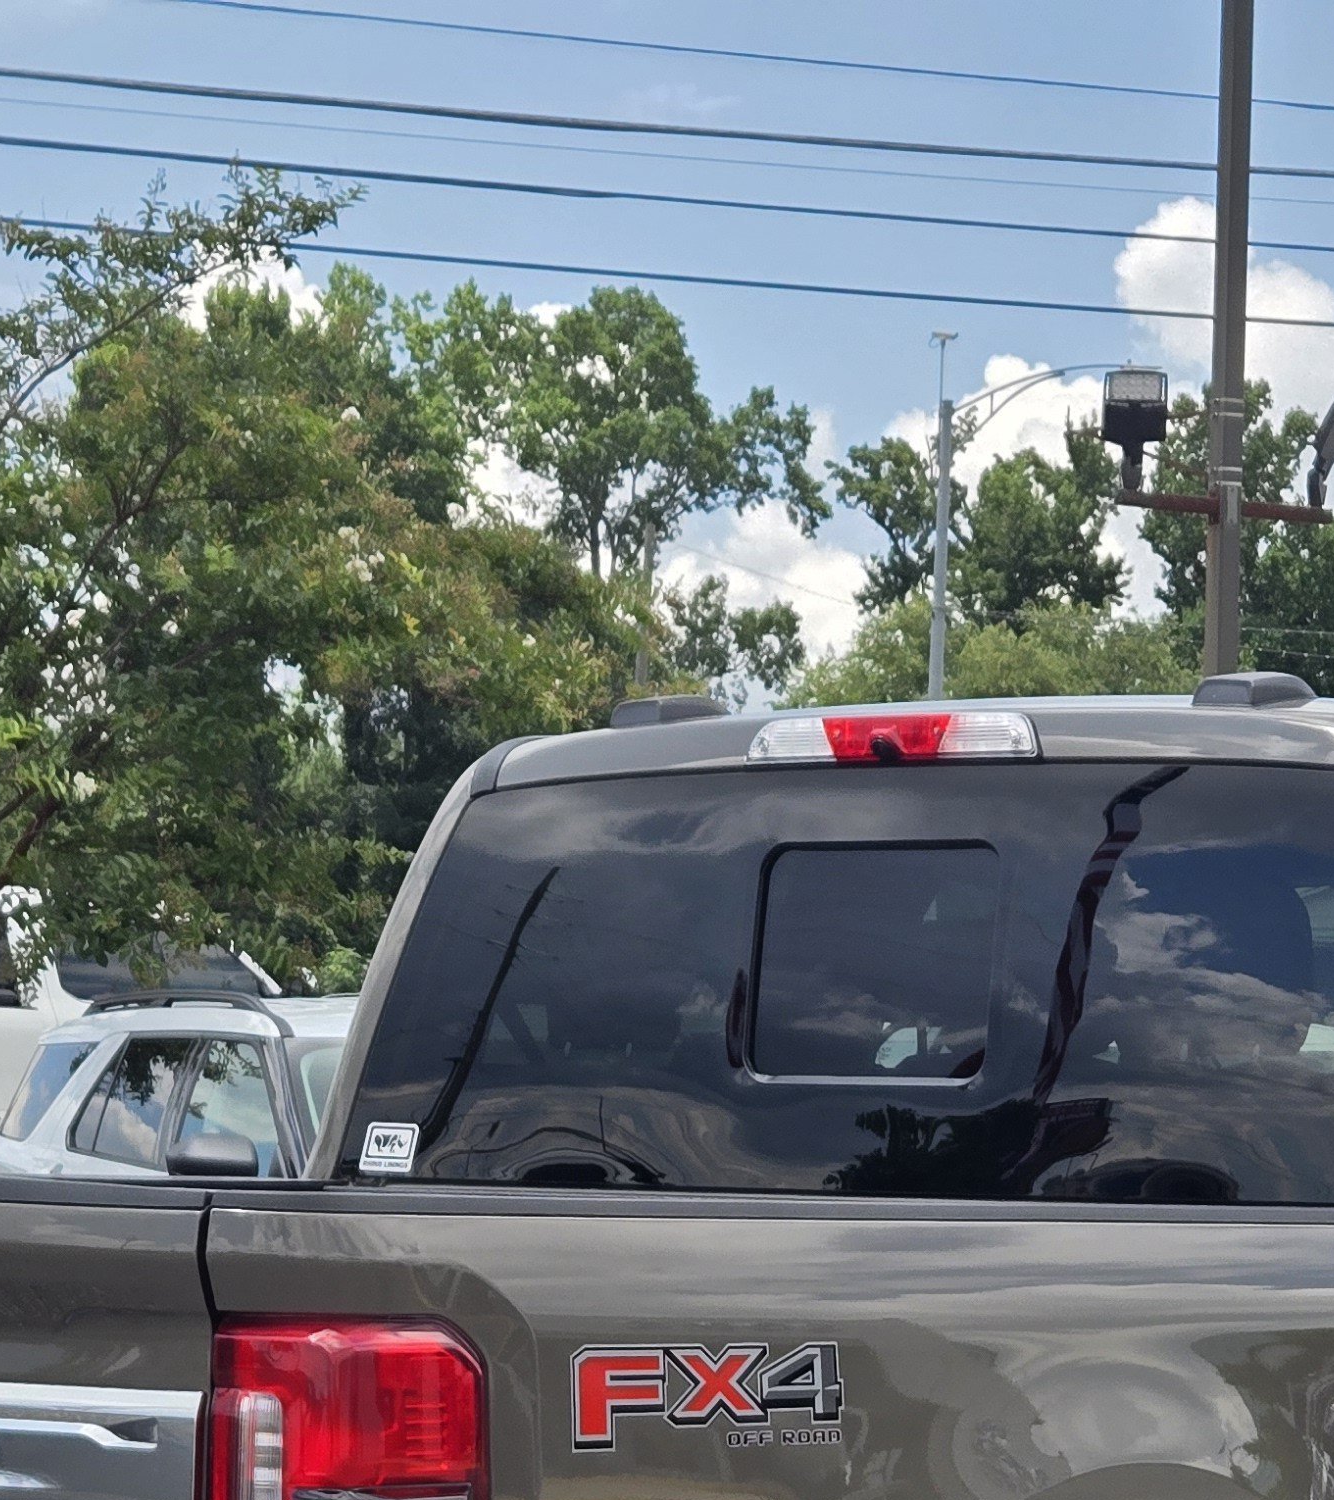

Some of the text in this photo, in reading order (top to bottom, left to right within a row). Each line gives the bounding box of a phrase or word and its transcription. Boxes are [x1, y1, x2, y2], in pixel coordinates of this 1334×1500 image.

[570, 1341, 844, 1453] FX4
[727, 1428, 843, 1447] OFF ROAD
